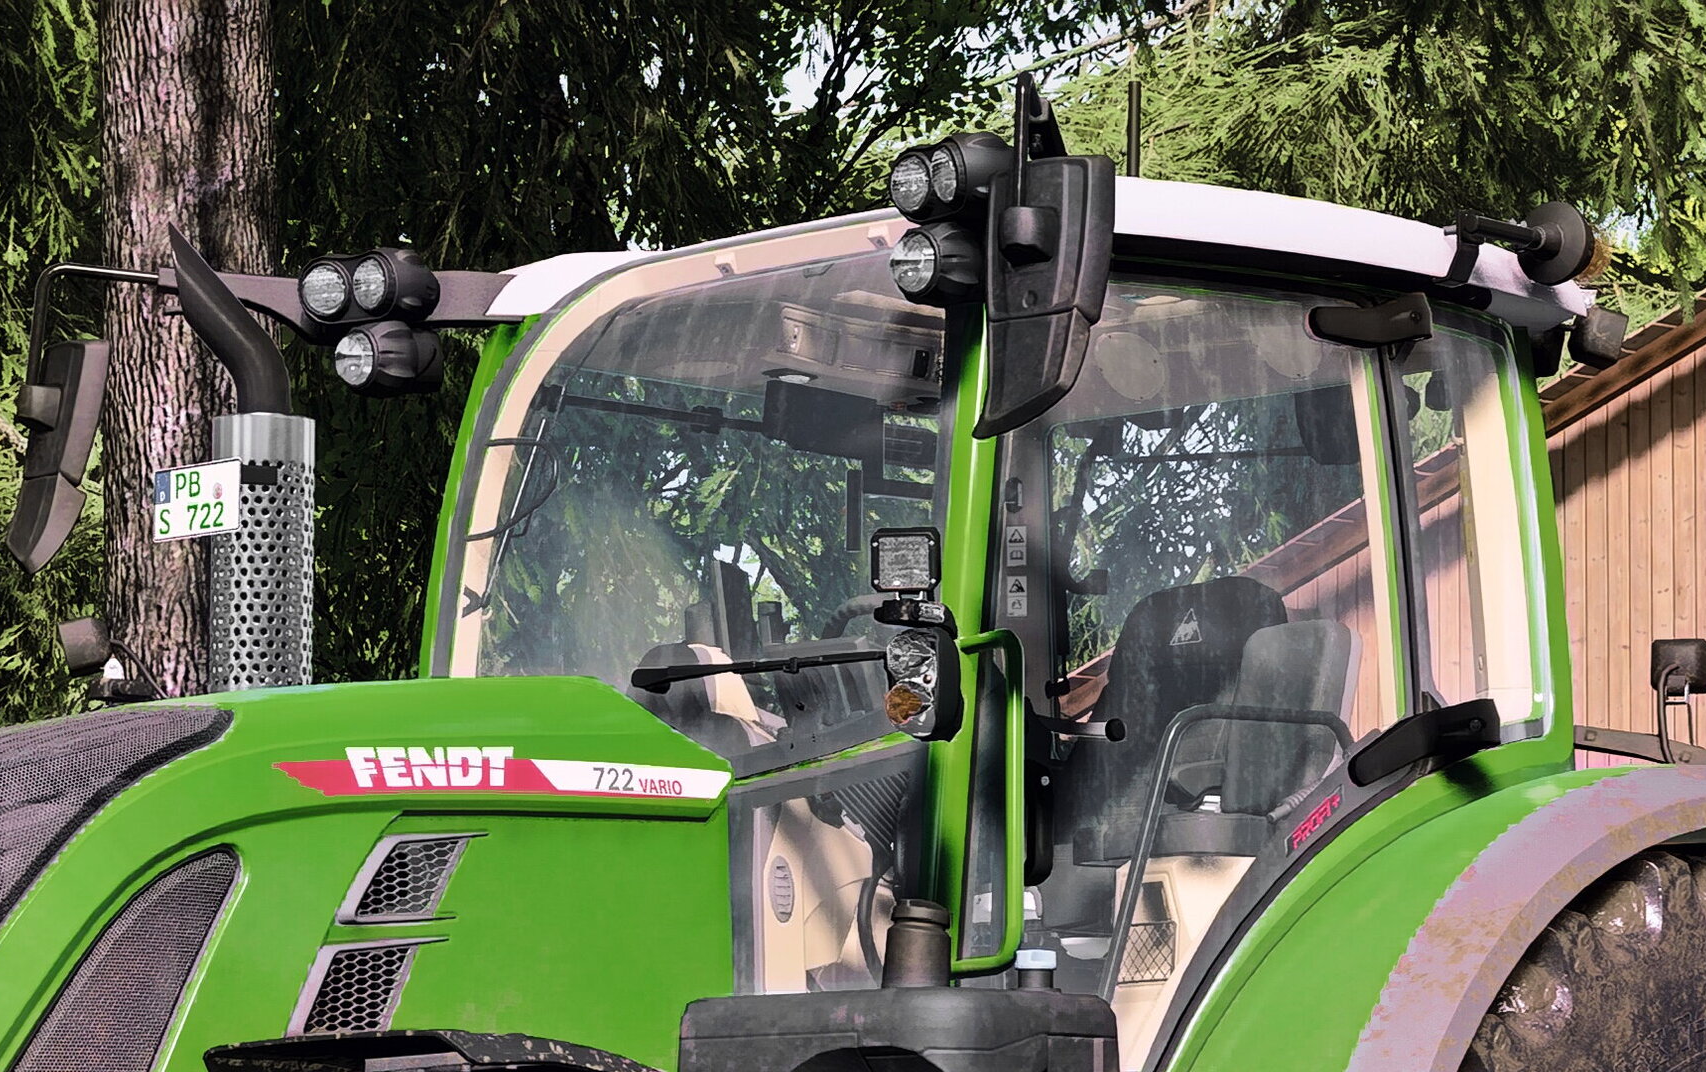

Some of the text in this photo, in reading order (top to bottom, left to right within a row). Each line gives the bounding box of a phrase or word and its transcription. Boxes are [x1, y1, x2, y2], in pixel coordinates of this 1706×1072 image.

[175, 471, 201, 499] PB
[159, 501, 224, 535] S 722
[345, 746, 514, 788] FENDT
[592, 767, 683, 796] 722 VARIO
